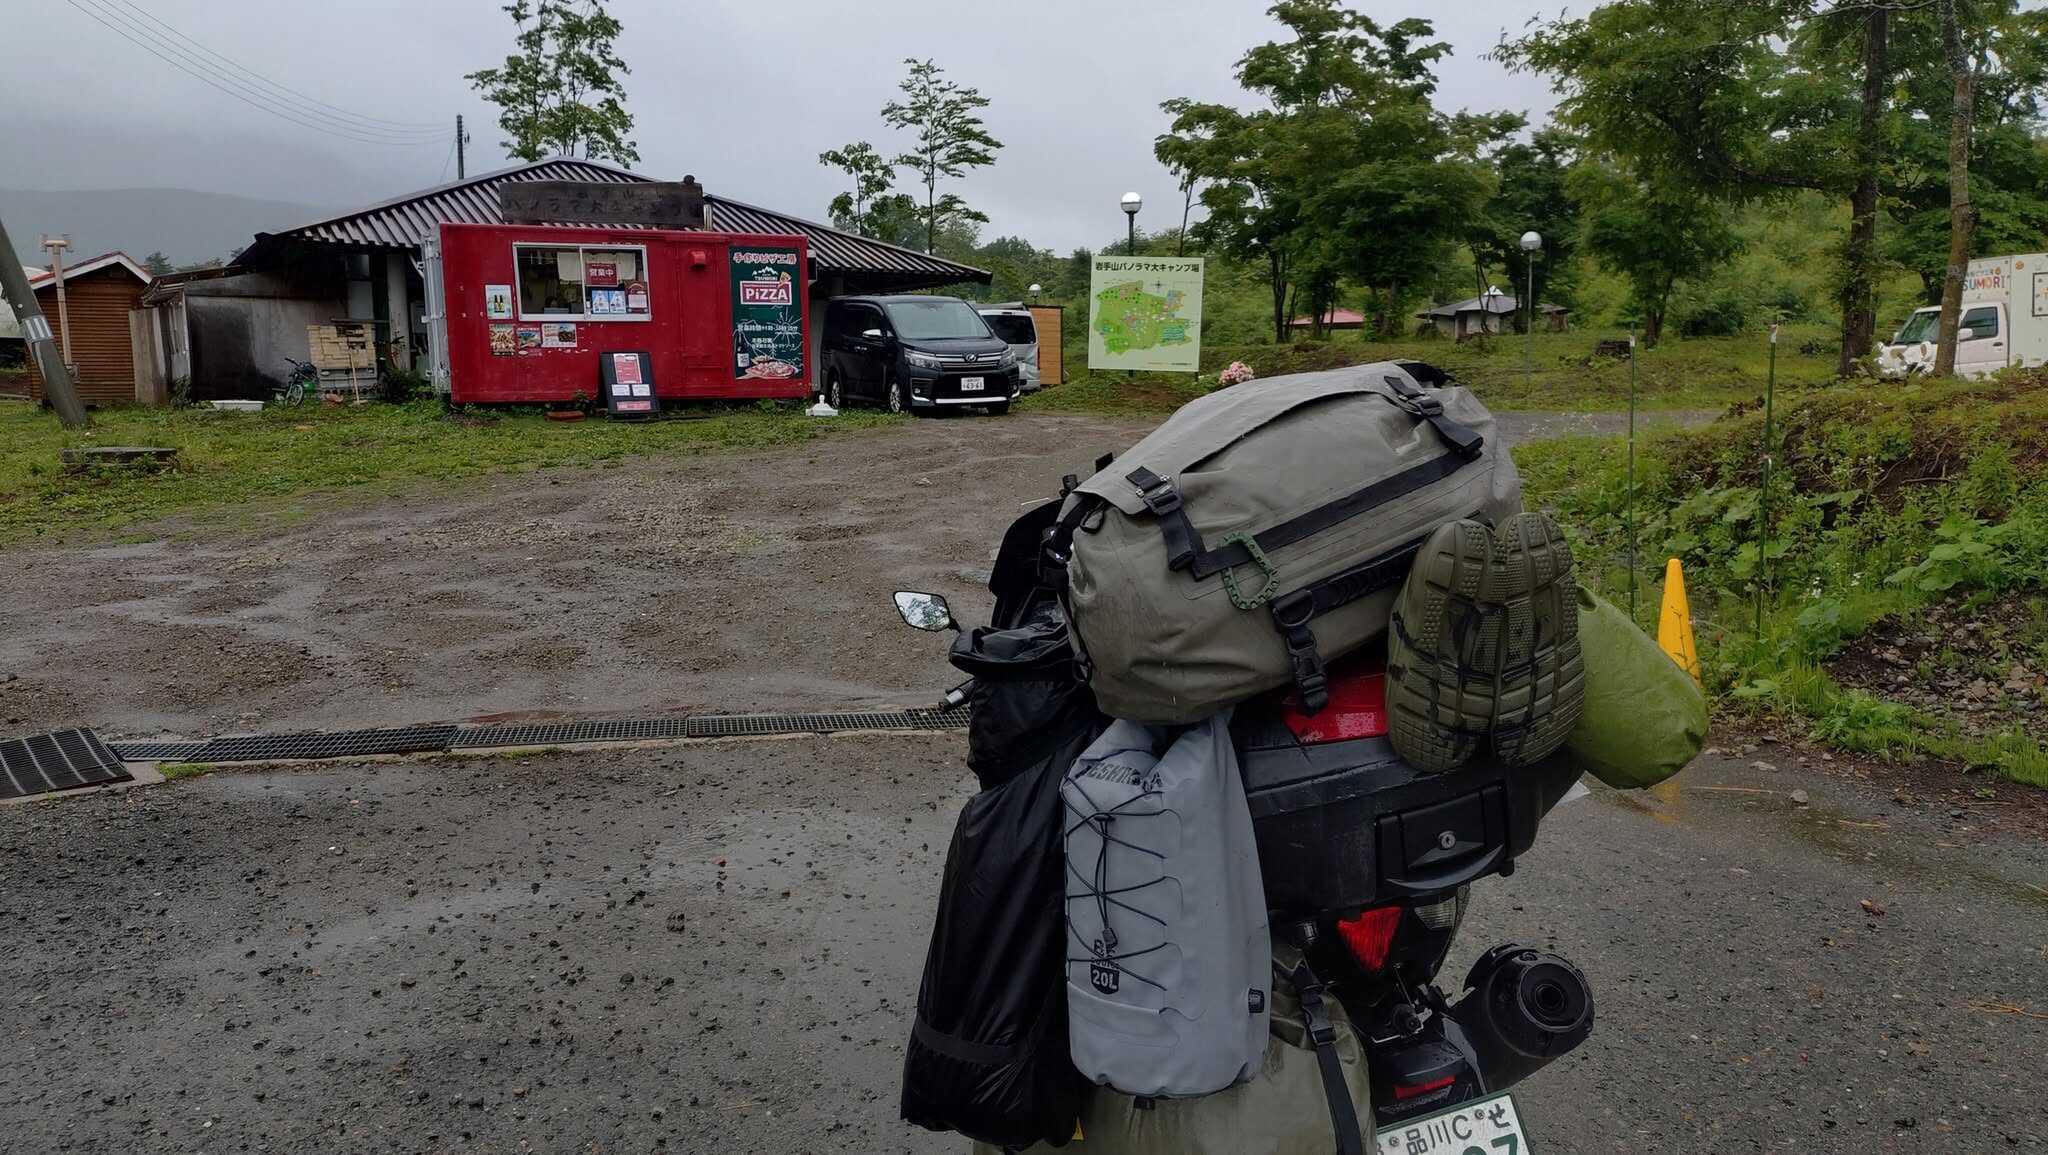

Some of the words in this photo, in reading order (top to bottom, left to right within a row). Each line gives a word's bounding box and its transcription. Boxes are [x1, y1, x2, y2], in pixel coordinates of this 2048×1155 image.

[1095, 262, 1200, 273] 岩手山パノラマ大キャンプ場
[745, 288, 788, 300] PiZZA
[1092, 969, 1118, 990] 20L
[1488, 1103, 1511, 1129] せ
